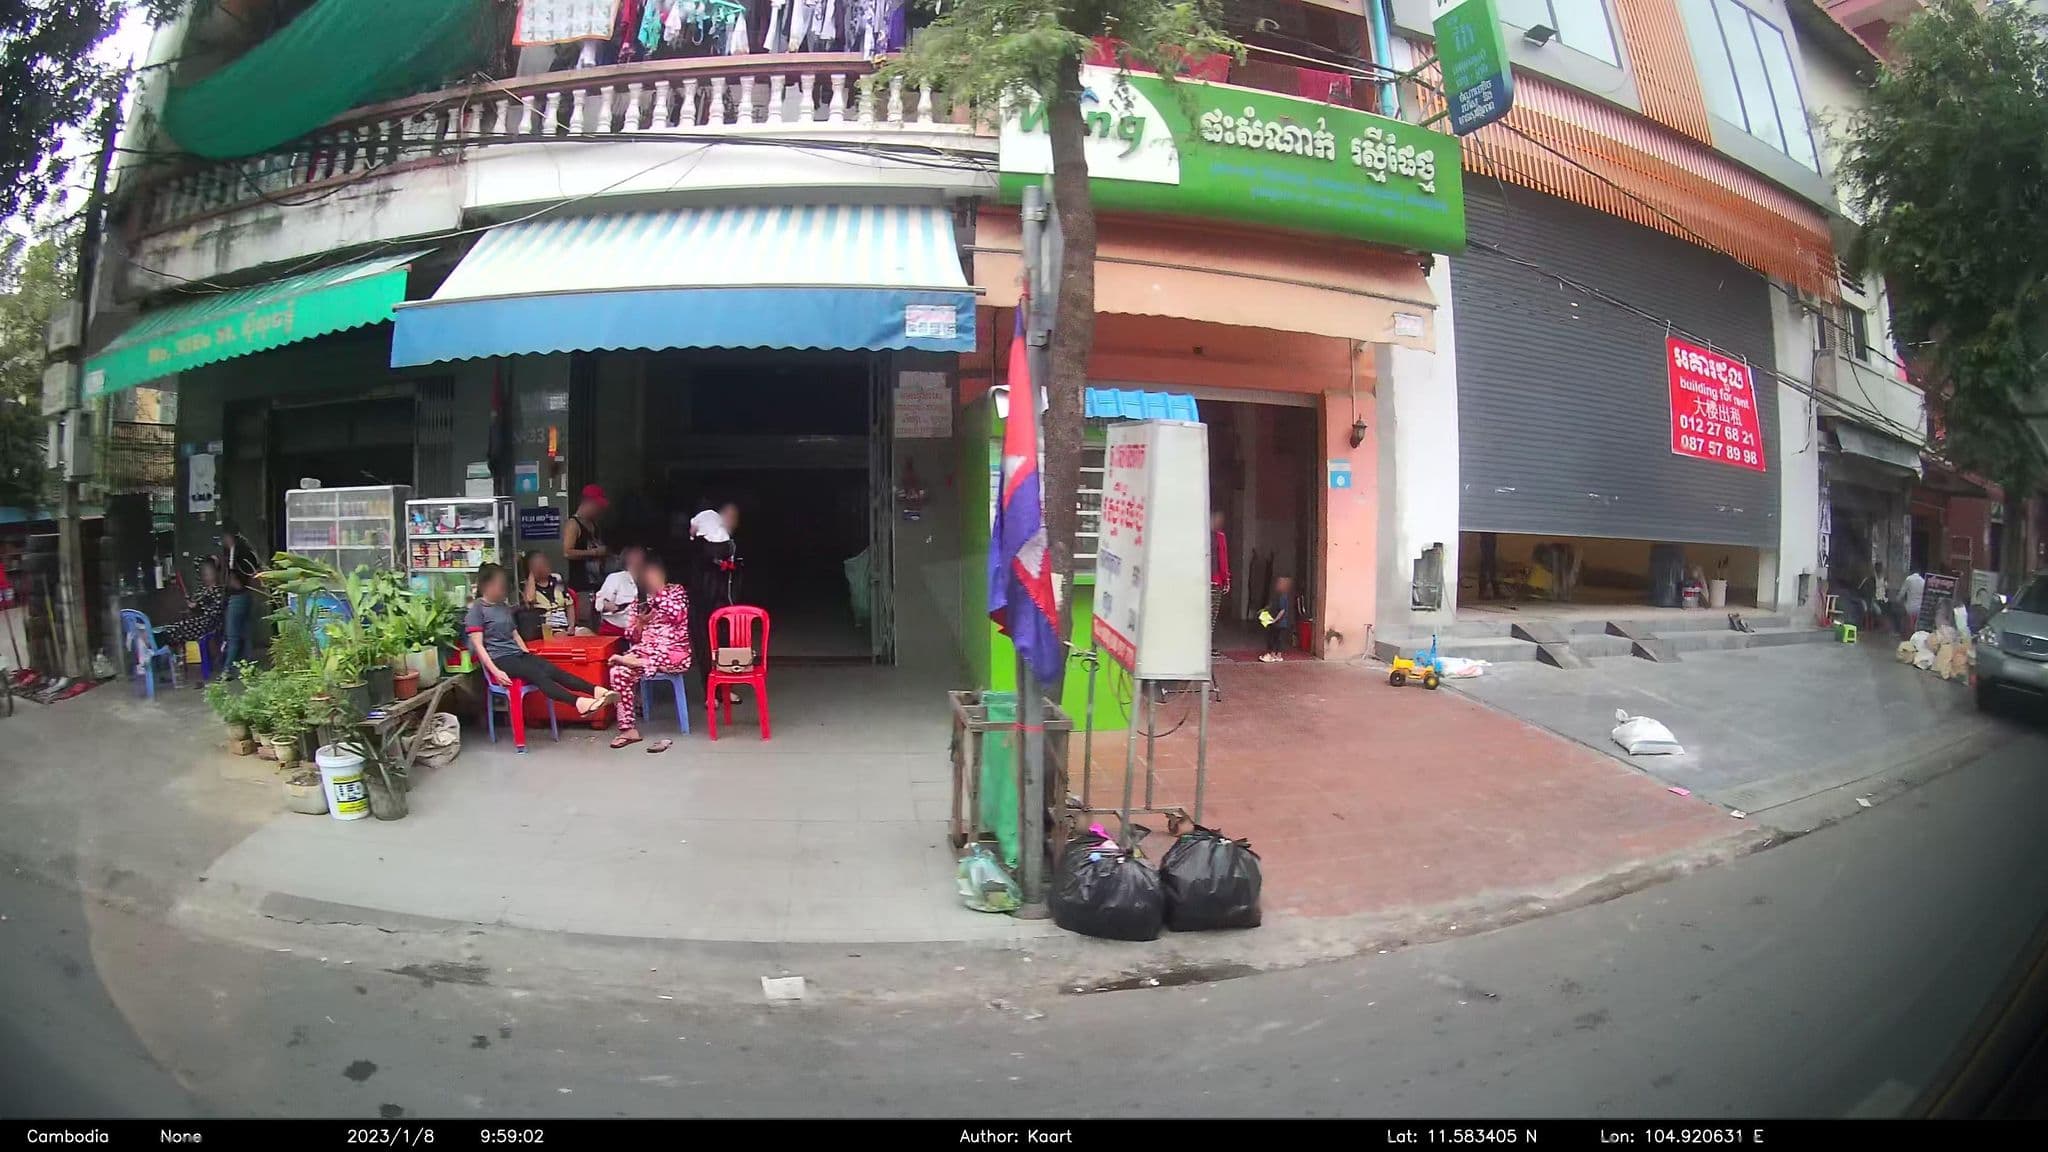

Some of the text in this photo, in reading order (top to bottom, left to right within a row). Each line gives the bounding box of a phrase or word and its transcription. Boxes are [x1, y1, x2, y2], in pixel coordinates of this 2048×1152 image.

[1680, 376, 1719, 401] building
[1719, 388, 1733, 402] for
[1680, 414, 1755, 447] 012 27 68 21
[1681, 434, 1758, 465] 087 57 89 98
